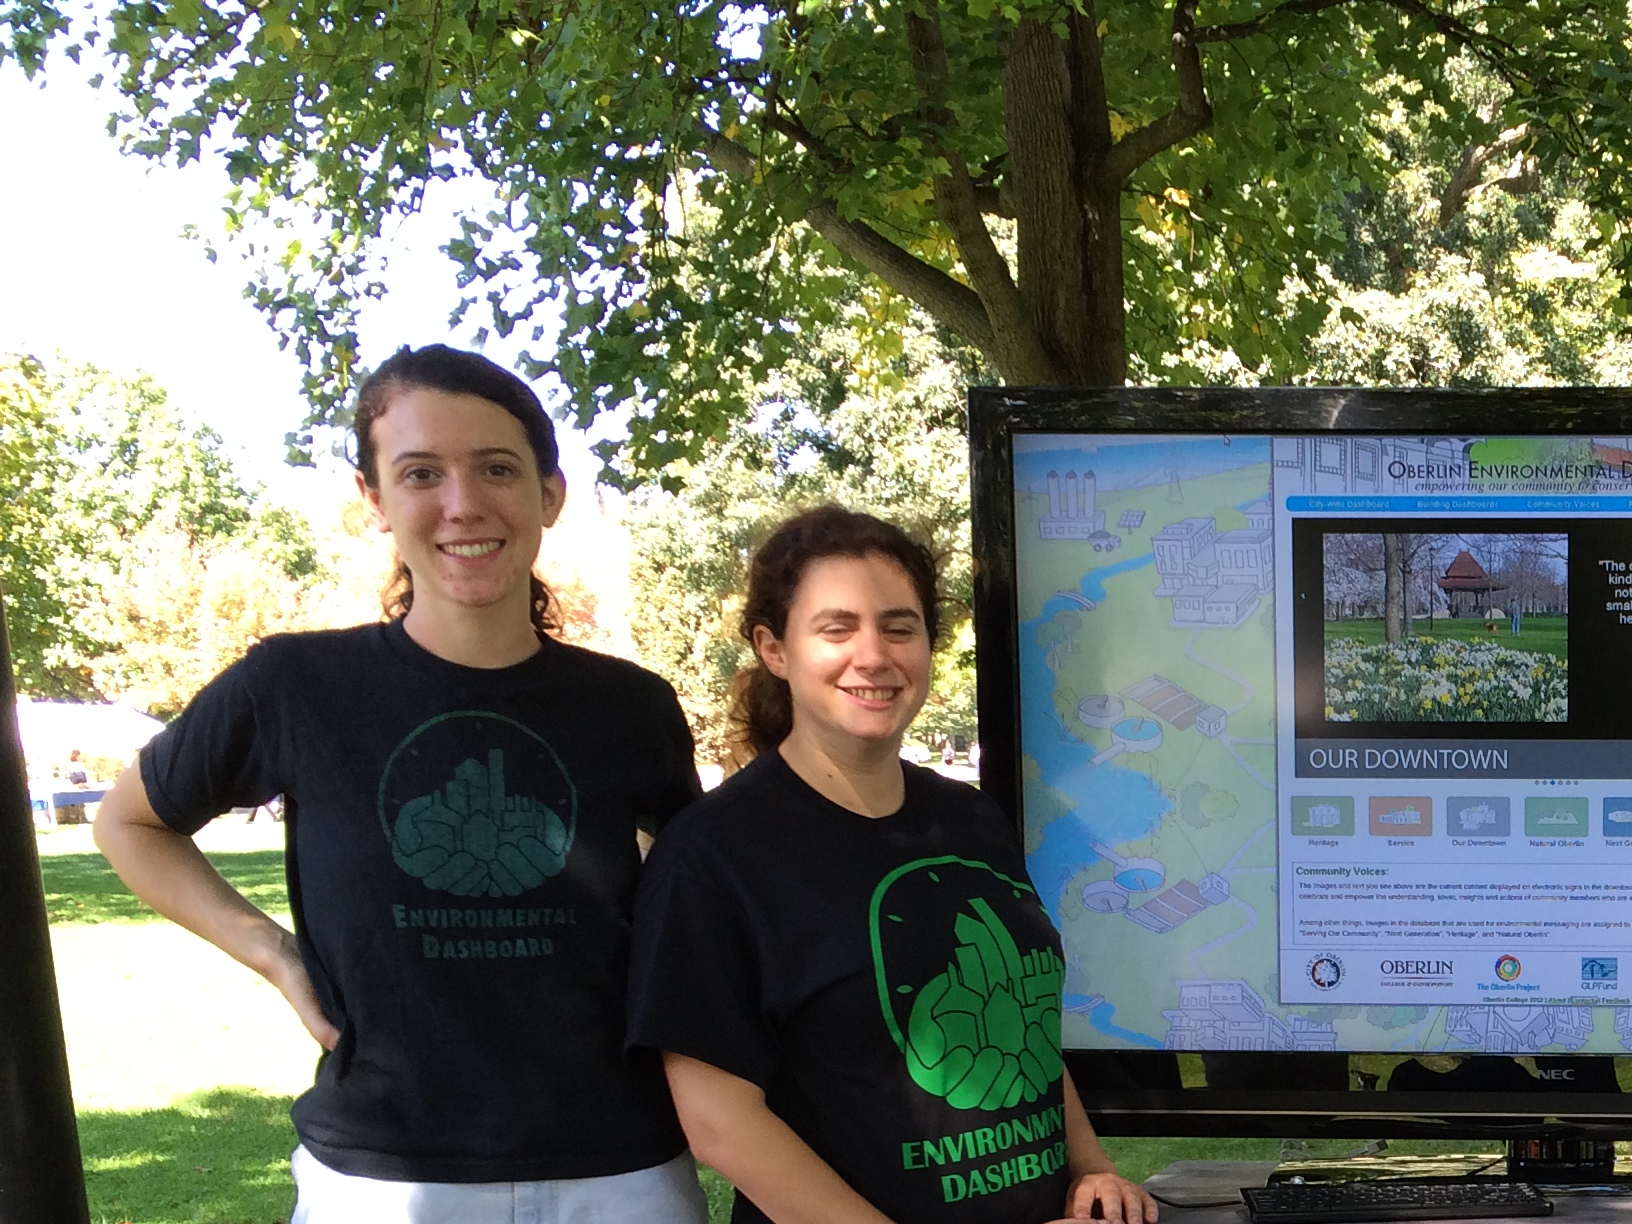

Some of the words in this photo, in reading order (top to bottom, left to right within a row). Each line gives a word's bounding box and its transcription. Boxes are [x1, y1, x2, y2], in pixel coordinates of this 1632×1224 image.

[1388, 460, 1462, 479] OBERLIN
[1469, 460, 1615, 479] ENVIRONMENTAL
[1415, 481, 1485, 494] empowering
[1489, 482, 1509, 490] our
[1511, 481, 1574, 494] community
[1578, 481, 1589, 490] to
[1346, 500, 1390, 508] Dashboard
[1417, 500, 1450, 509] Building
[1451, 500, 1499, 508] Dashboards
[1527, 500, 1571, 509] Community
[1599, 560, 1626, 572] "The
[1608, 574, 1632, 585] kind
[1614, 588, 1632, 598] not
[1309, 748, 1359, 769] OUR
[1365, 748, 1508, 769] DOWNTOWN
[1308, 839, 1339, 848] Heritage
[1387, 839, 1415, 847] Service
[1451, 839, 1466, 847] Our
[1467, 839, 1506, 847] Downtown
[1529, 839, 1556, 847] Natural
[1557, 839, 1585, 847] Oberlin
[1605, 839, 1623, 847] Next
[1296, 866, 1351, 878] Community
[1353, 866, 1389, 876] Voices:
[392, 903, 578, 929] ENVIRONMENTAL
[422, 933, 555, 960] DASHBOARD
[1380, 960, 1454, 975] OBERLIN
[1477, 982, 1490, 990] The
[1490, 982, 1515, 990] Oberlin
[1516, 982, 1540, 992] Project
[1538, 1069, 1576, 1081] NEC
